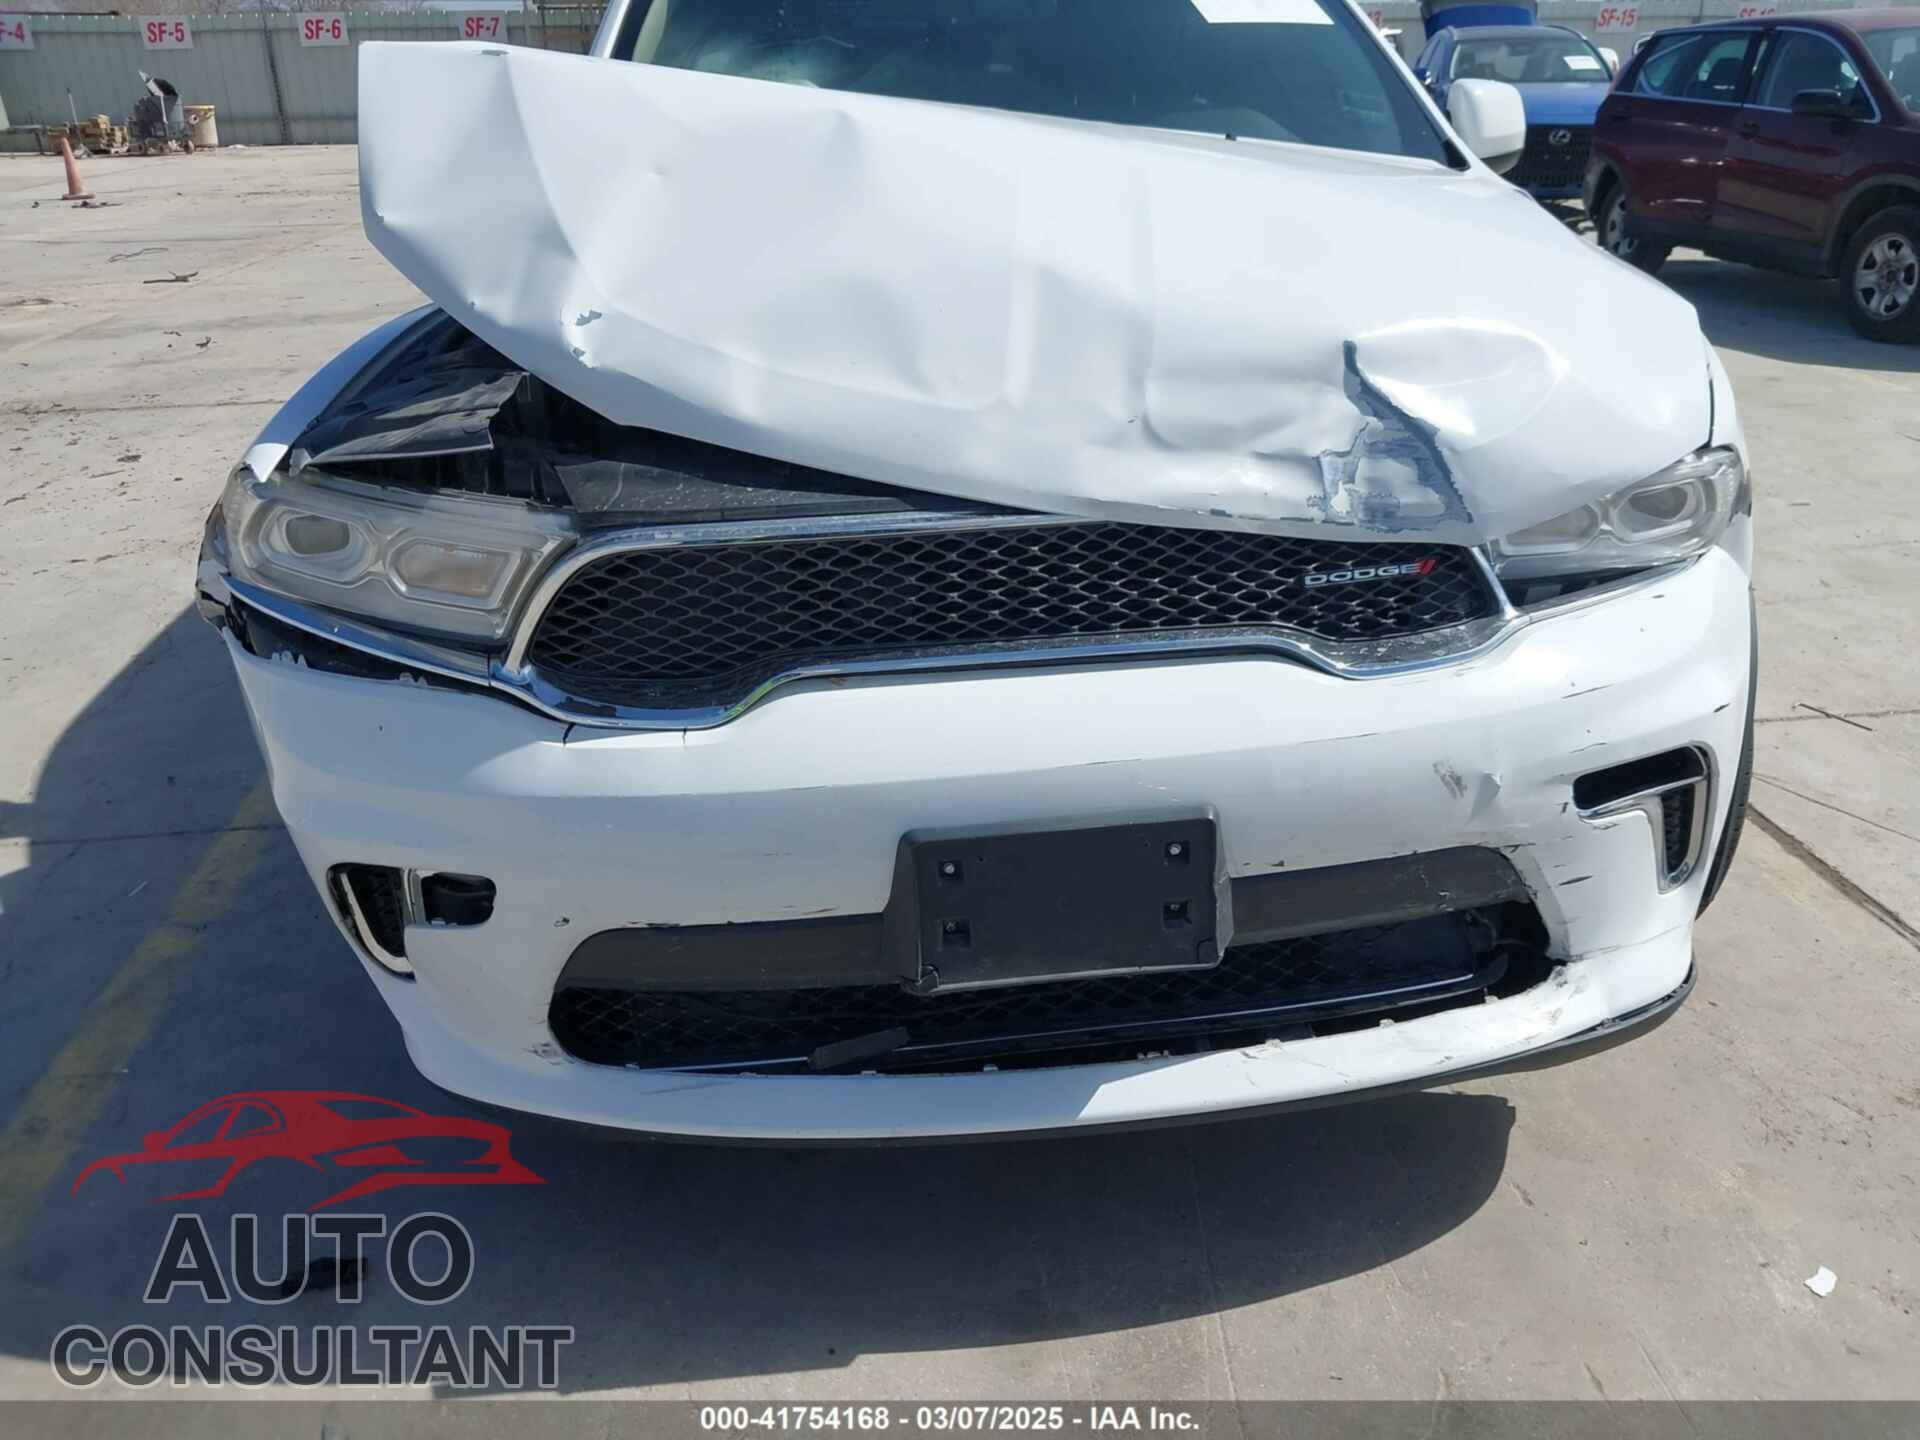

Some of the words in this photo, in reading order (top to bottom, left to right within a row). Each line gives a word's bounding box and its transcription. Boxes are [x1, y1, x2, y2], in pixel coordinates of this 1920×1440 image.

[465, 17, 500, 37] SF-7
[1599, 8, 1636, 26] SF-15
[147, 22, 185, 43] SF-5
[305, 19, 341, 40] SF-6
[1304, 563, 1421, 585] DODGE
